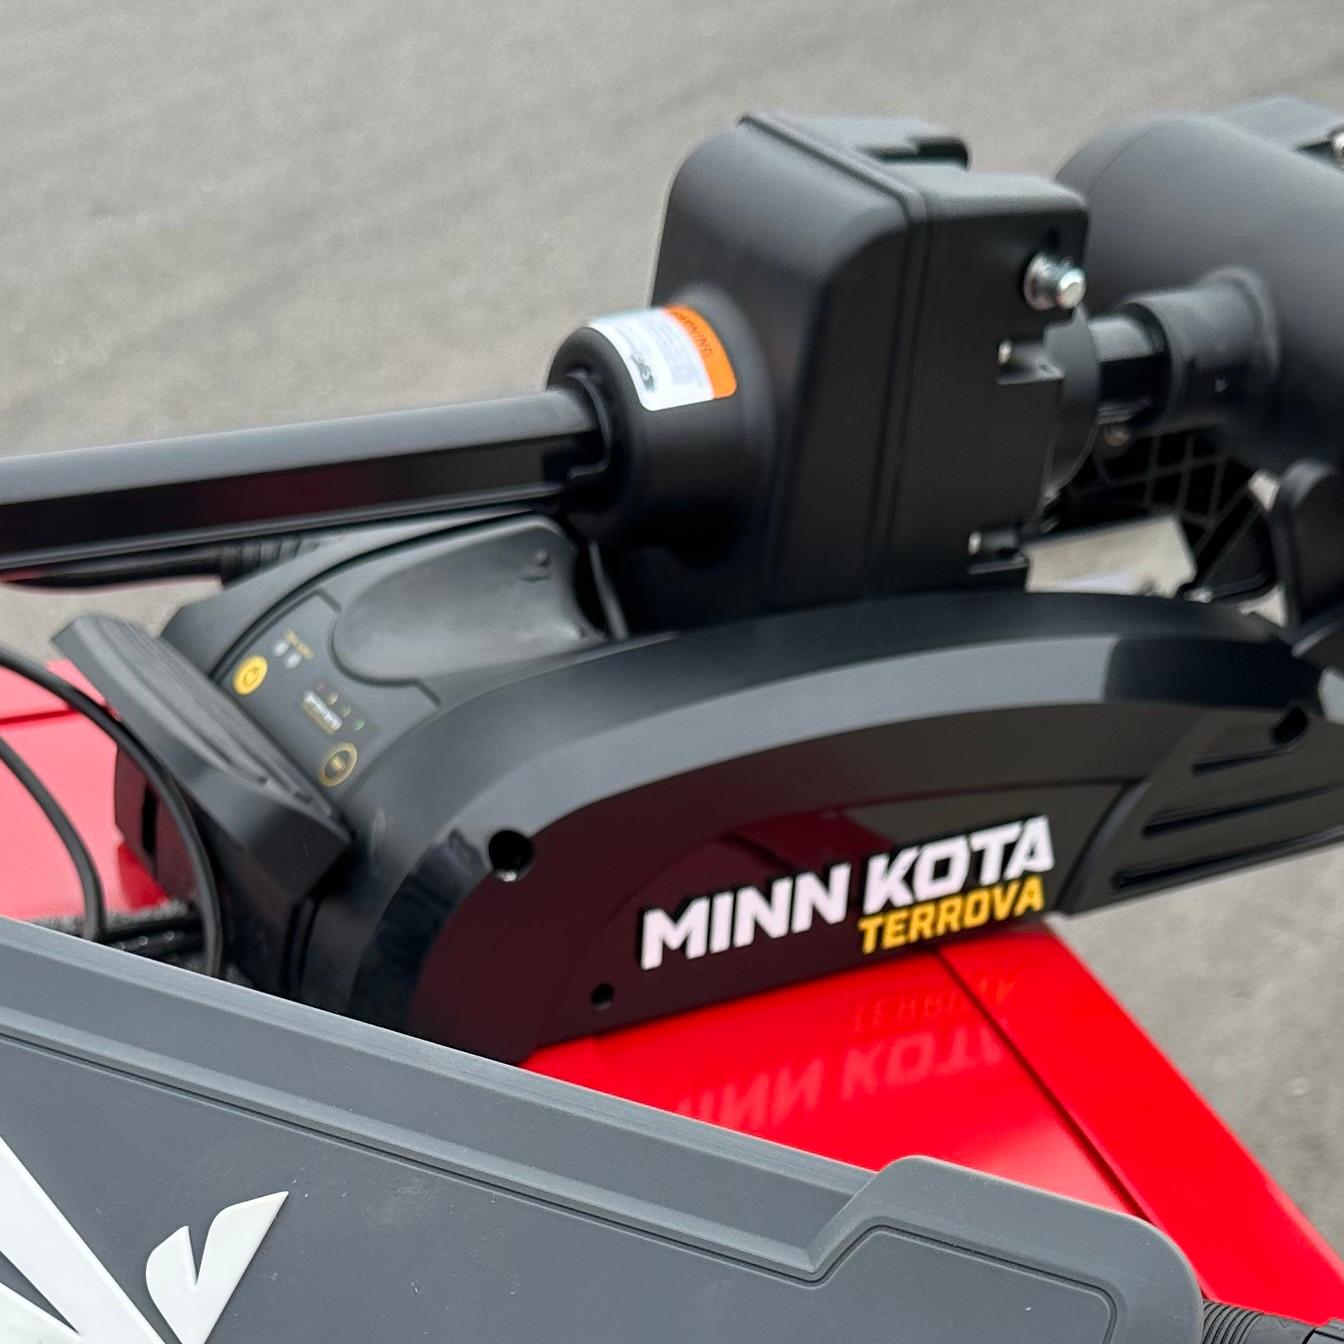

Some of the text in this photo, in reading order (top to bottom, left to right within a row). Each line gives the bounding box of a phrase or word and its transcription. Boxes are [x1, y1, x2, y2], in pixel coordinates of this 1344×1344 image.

[640, 815, 1055, 971] MINN KOTA
[858, 874, 1046, 955] TERROVA
